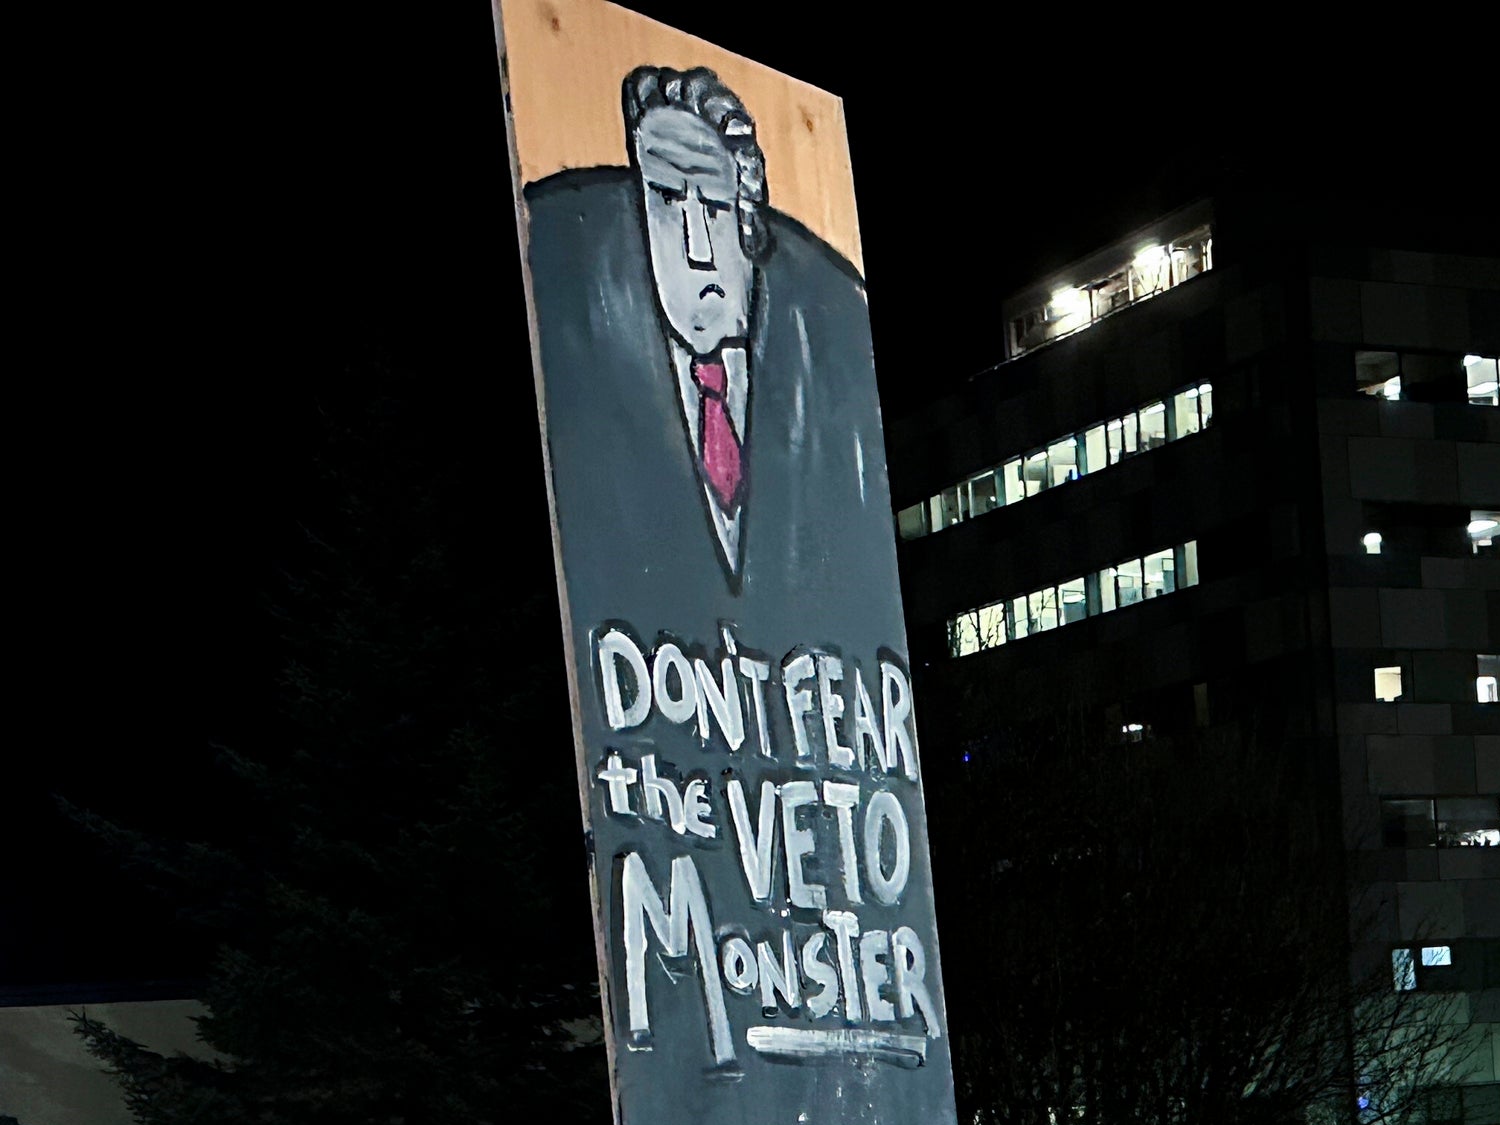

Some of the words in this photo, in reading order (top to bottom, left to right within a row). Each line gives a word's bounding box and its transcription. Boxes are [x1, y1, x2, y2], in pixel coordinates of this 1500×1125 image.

[783, 653, 918, 783] FEAR
[597, 753, 717, 839] the
[727, 779, 911, 910] VETO
